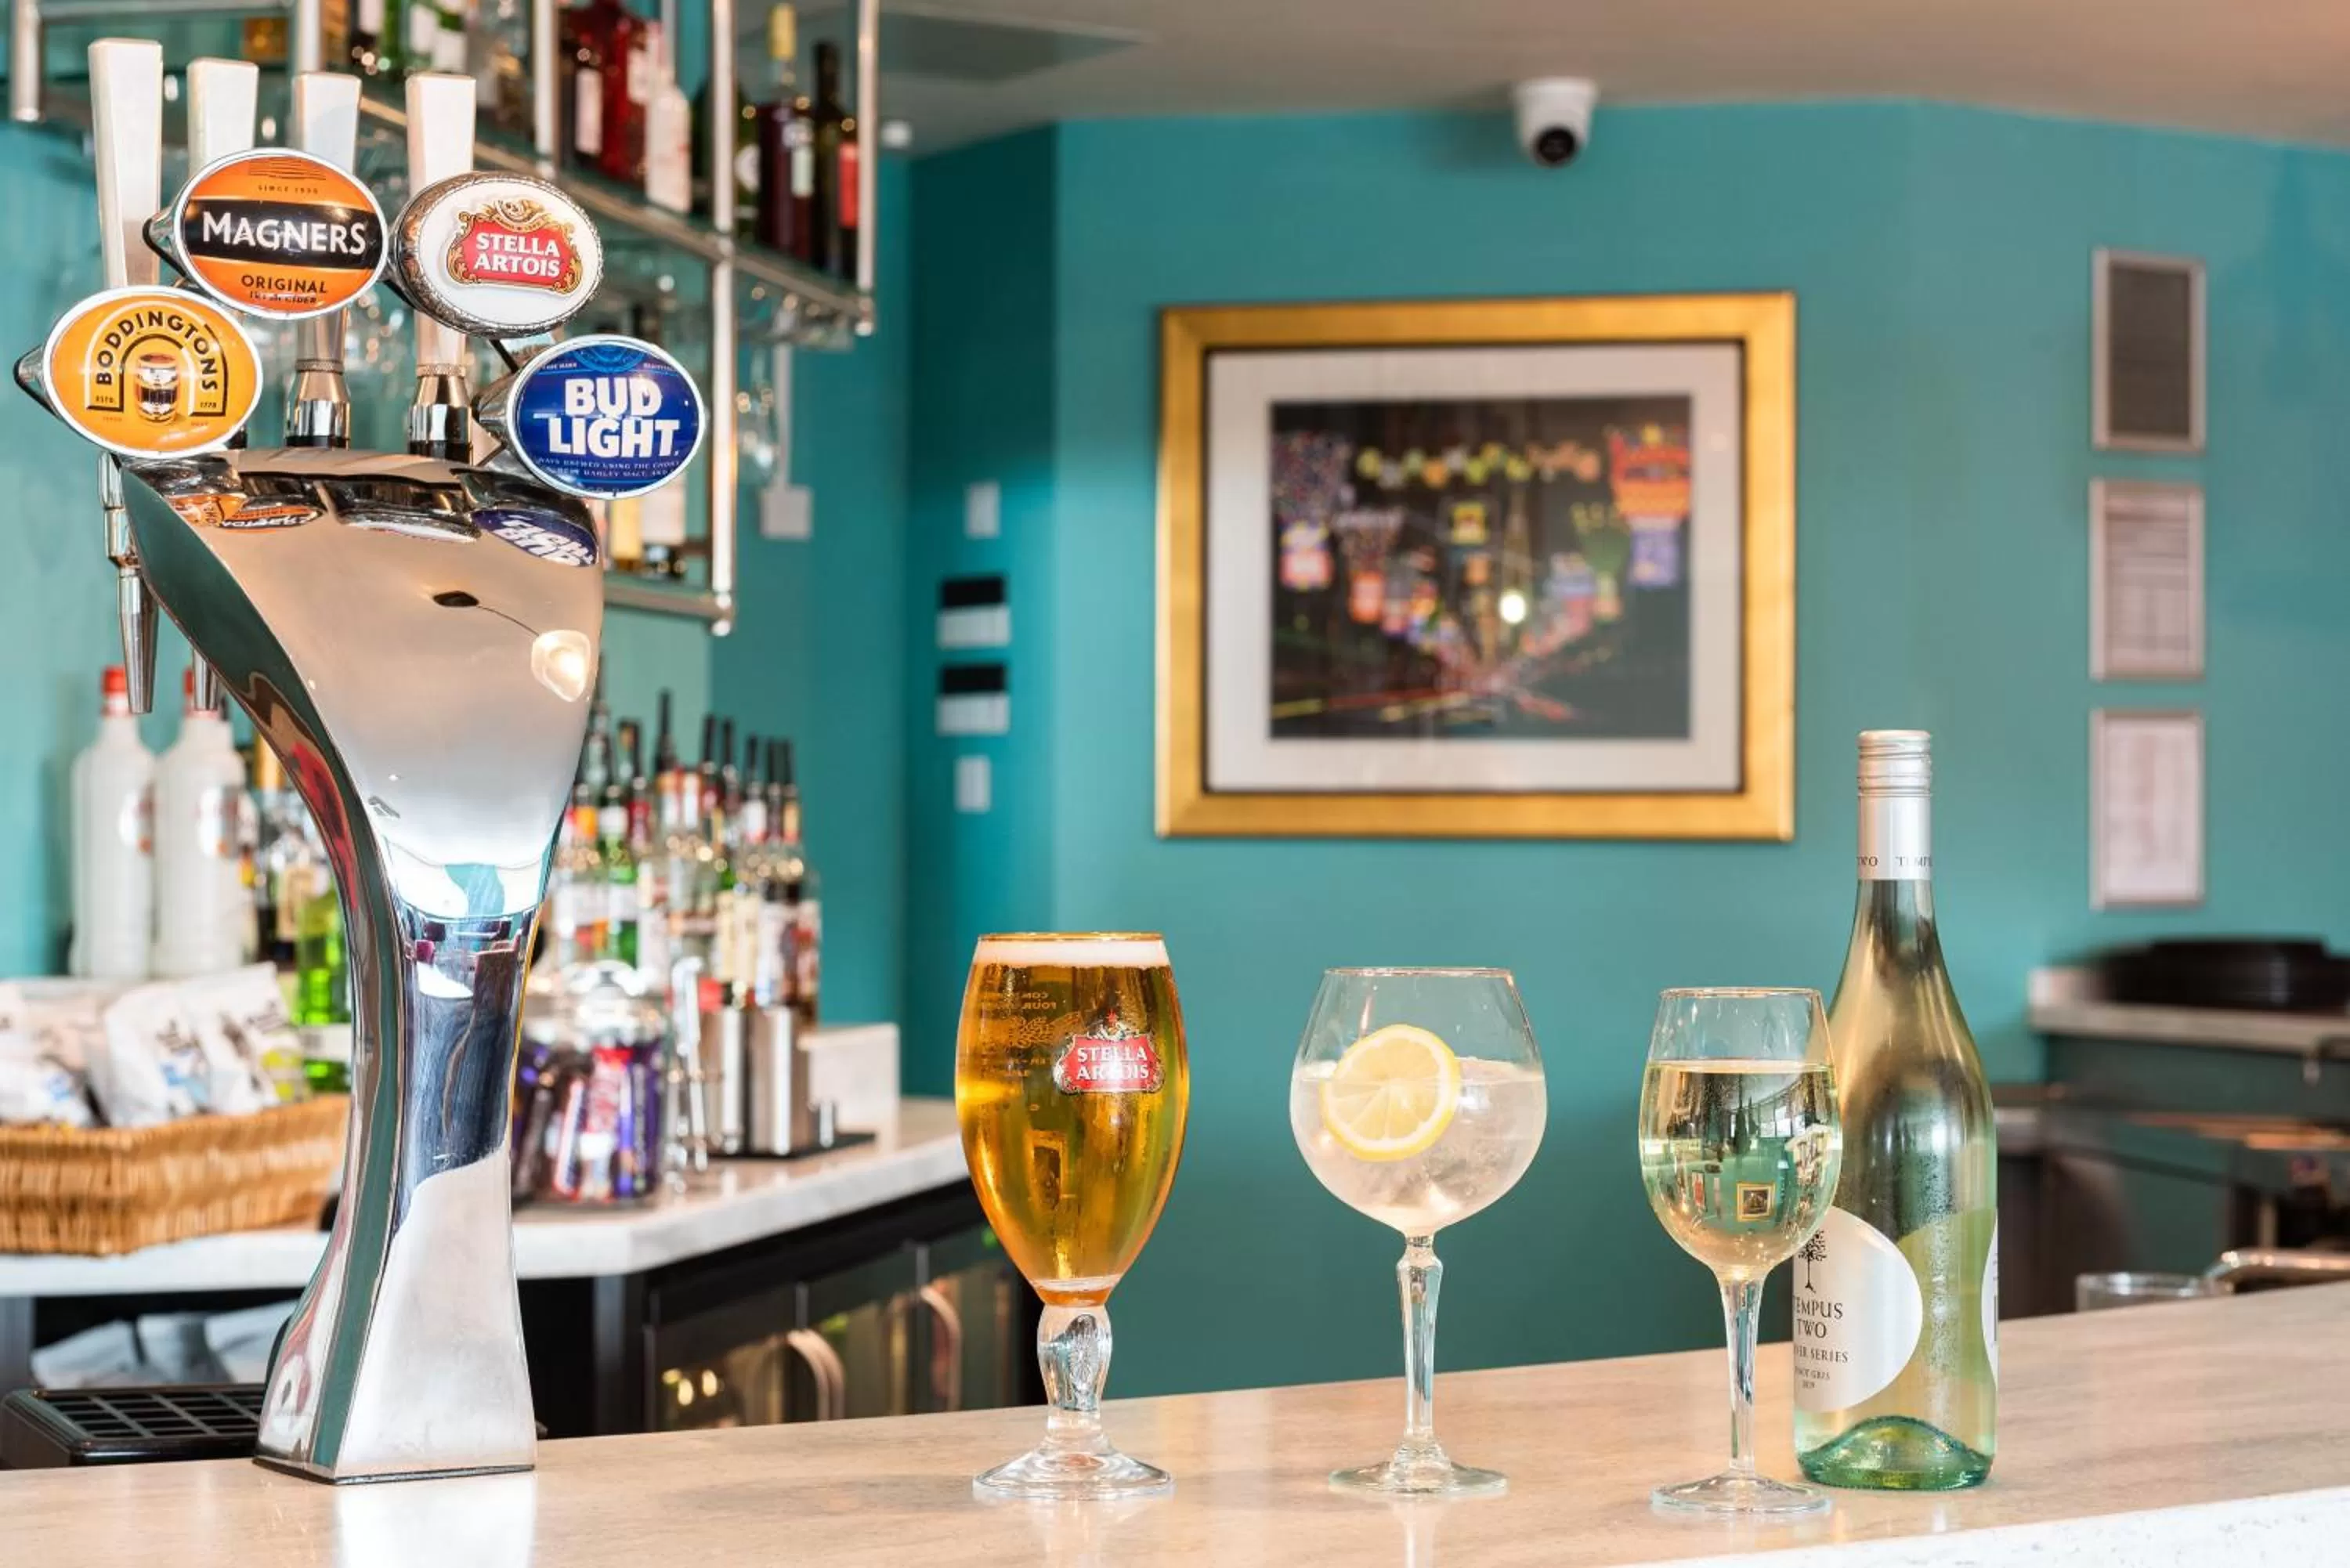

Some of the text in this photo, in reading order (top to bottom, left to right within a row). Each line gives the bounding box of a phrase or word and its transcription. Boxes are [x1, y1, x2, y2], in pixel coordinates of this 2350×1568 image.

[202, 211, 367, 255] MAGNERS
[475, 232, 560, 258] STELLA
[473, 253, 561, 278] ARTOIS
[240, 274, 327, 294] ORIGINAL
[96, 311, 218, 391] BODDINGTONS
[565, 377, 663, 417] BUD
[548, 415, 681, 459] LIGHT
[1076, 1046, 1148, 1063] STELLA
[1076, 1064, 1150, 1080] AROIS
[1795, 1297, 1843, 1320] EMPUS
[1797, 1318, 1828, 1339] TWO
[1810, 1348, 1849, 1364] SERIES
